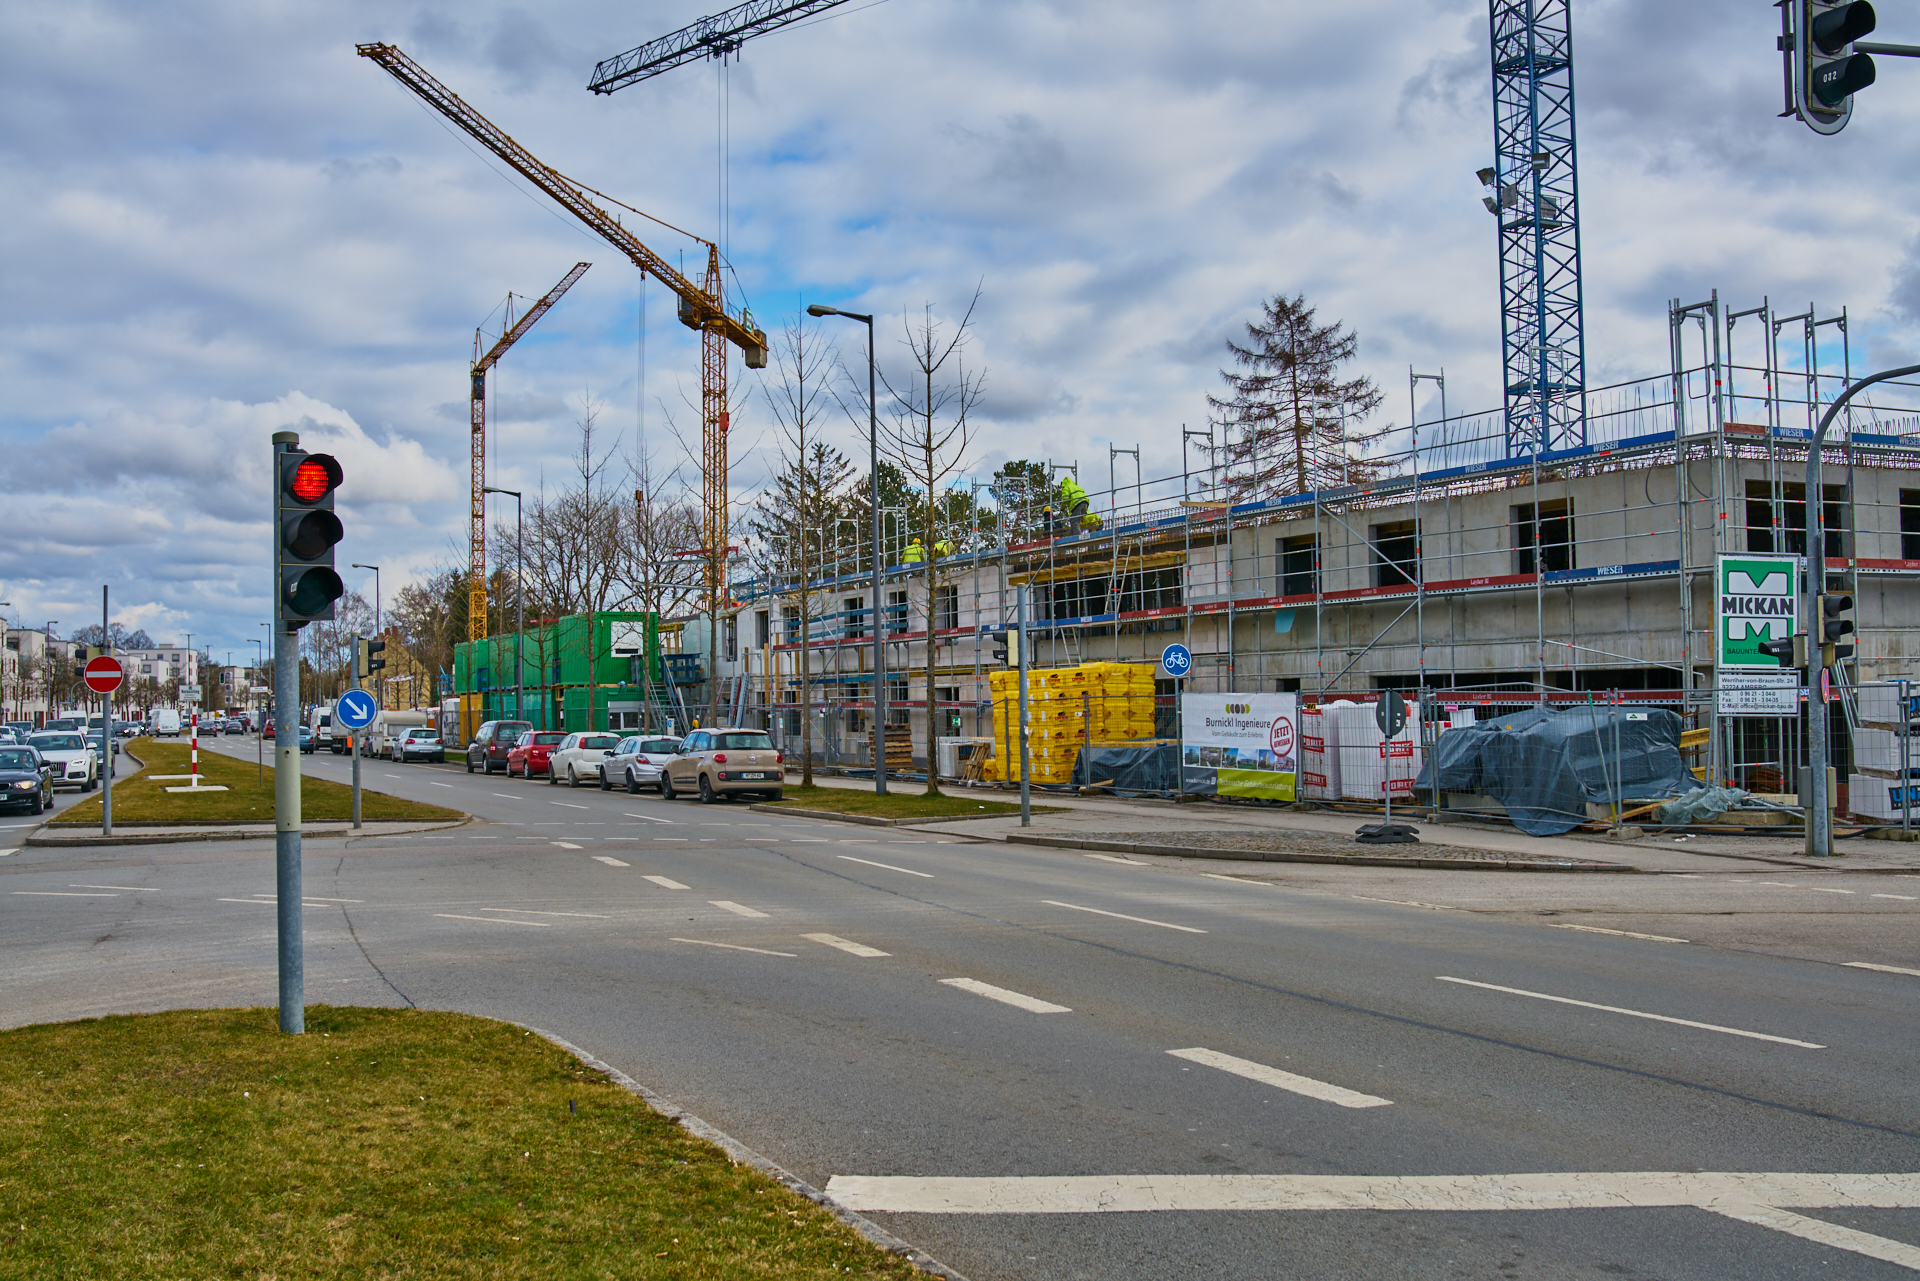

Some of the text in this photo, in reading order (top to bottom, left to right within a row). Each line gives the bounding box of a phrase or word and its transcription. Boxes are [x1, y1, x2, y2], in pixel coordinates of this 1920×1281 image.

[1779, 428, 1804, 438] WIESER
[1593, 441, 1619, 452] WIESER
[1464, 462, 1487, 474] WIESER
[1264, 498, 1282, 508] WIESER
[1597, 566, 1624, 576] WIESER
[1722, 596, 1794, 615] MICKAN
[1206, 717, 1271, 730] Burnickl Ingenieure
[1274, 726, 1289, 739] JETZT
[1220, 778, 1292, 792] Technische Gebäudeausrüstung
